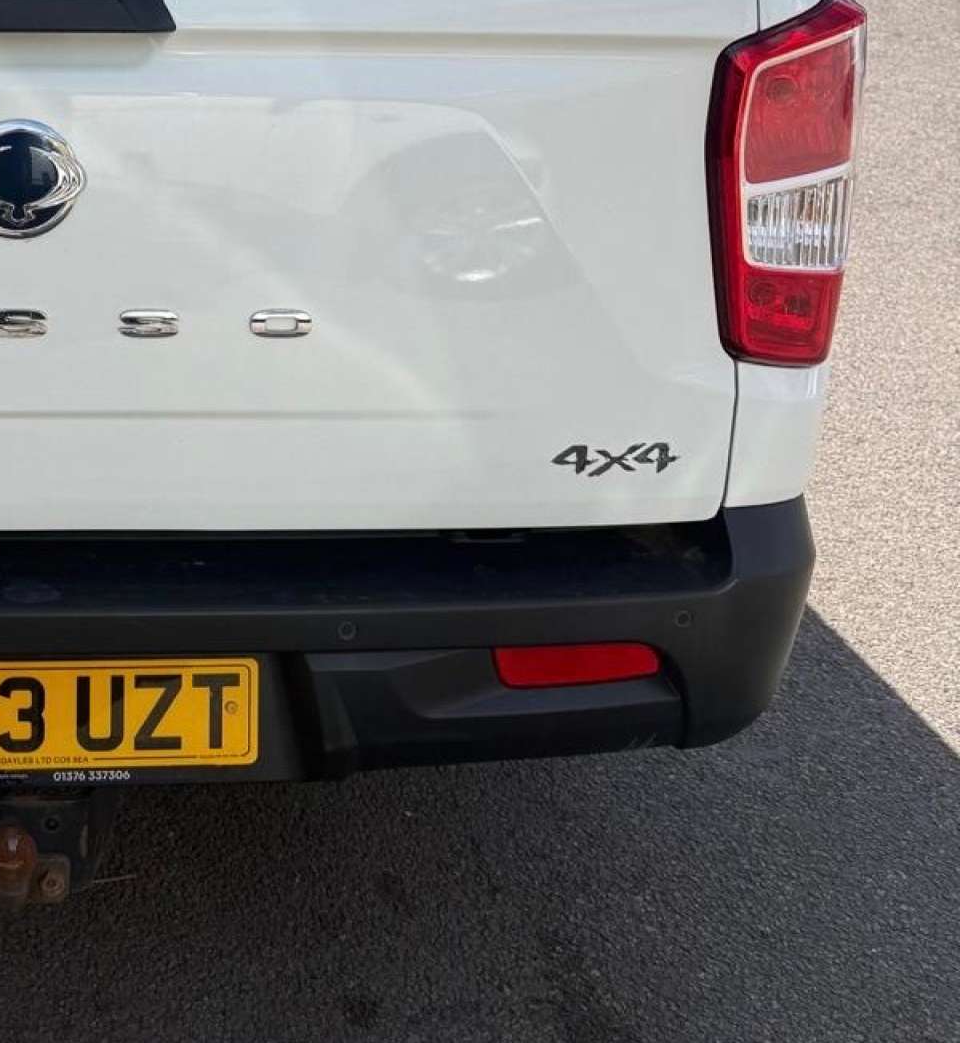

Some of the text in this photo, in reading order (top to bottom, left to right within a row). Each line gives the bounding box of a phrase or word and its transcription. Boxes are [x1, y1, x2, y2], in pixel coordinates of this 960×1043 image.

[76, 673, 240, 752] UZT
[53, 770, 131, 782] 01376 337306
